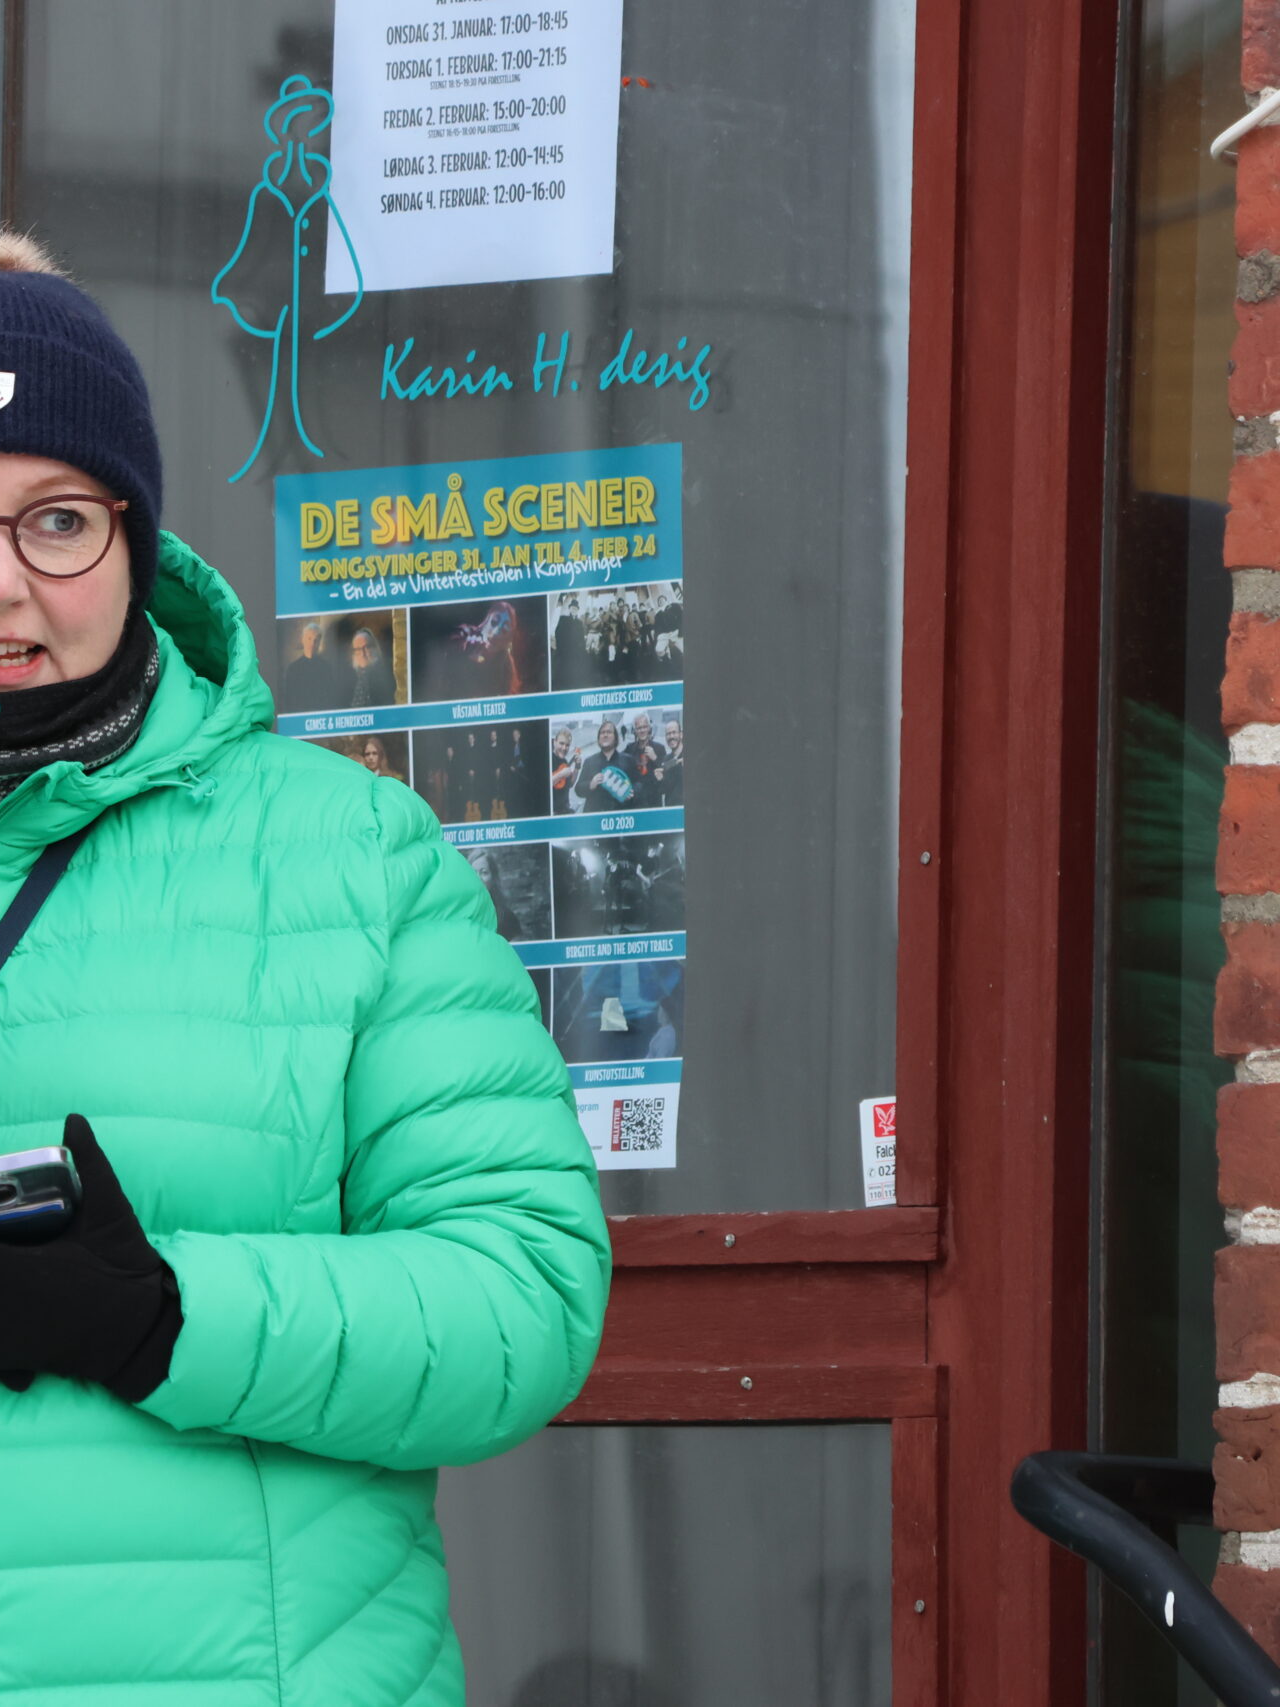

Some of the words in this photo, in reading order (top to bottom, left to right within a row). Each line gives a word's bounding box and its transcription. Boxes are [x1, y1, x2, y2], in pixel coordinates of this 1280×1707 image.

[386, 23, 429, 45] ONSDAG
[432, 22, 447, 42] 31.
[450, 17, 497, 40] JANUAR:
[500, 10, 569, 35] 17:00-18:45
[385, 58, 432, 81] TORSDAG
[436, 57, 444, 77] 1.
[447, 52, 498, 76] FEBRUAR:
[501, 46, 567, 71] 17:00-21:15
[488, 74, 521, 85] FORESTILLING
[383, 108, 422, 129] FREDAG
[426, 106, 435, 126] 2.
[439, 102, 489, 125] FEBRUAR:
[493, 95, 567, 120] 15:00-20:00
[487, 122, 520, 134] FORESTILLING
[383, 156, 425, 178] LØRDAG
[428, 155, 437, 174] 3.
[440, 150, 491, 173] FEBRUAR:
[494, 144, 564, 168] 12:00-14:45
[381, 191, 422, 214] SØNDAG
[426, 190, 436, 210] 4.
[439, 186, 489, 209] FEBRUAR:
[493, 180, 566, 205] 12:00-16:00
[380, 337, 513, 400] Karin
[532, 330, 578, 397] H.
[599, 328, 711, 411] desig
[300, 500, 359, 549] DE
[371, 473, 474, 546] SMÅ
[483, 476, 657, 537] SCENER
[300, 550, 459, 582] KONGSVINGER
[462, 548, 486, 571] 31.
[490, 543, 531, 568] JAN
[535, 541, 565, 564] TIL
[568, 539, 587, 561] 4.
[592, 537, 629, 559] FEB
[632, 534, 656, 557] 24
[342, 582, 364, 600] En
[366, 575, 386, 600] del
[390, 581, 407, 595] av
[408, 563, 524, 594] Vinterfestivalen
[526, 562, 531, 580] i
[534, 555, 624, 587] Kongsvinger
[483, 702, 506, 716] TEATER
[581, 691, 627, 708] UNDERTAKERS
[628, 688, 654, 704] CIRKUS
[327, 717, 335, 731] &
[335, 713, 375, 729] HENRIKSEN
[458, 829, 475, 843] CLUB
[476, 828, 485, 841] DE
[601, 818, 615, 831] GLO
[616, 816, 635, 829] 2020
[597, 943, 612, 957] AND
[613, 942, 626, 955] THE
[627, 940, 649, 954] DUSTY
[650, 939, 673, 953] TRAILS
[584, 1066, 645, 1082] KUNSTUTSTILLING
